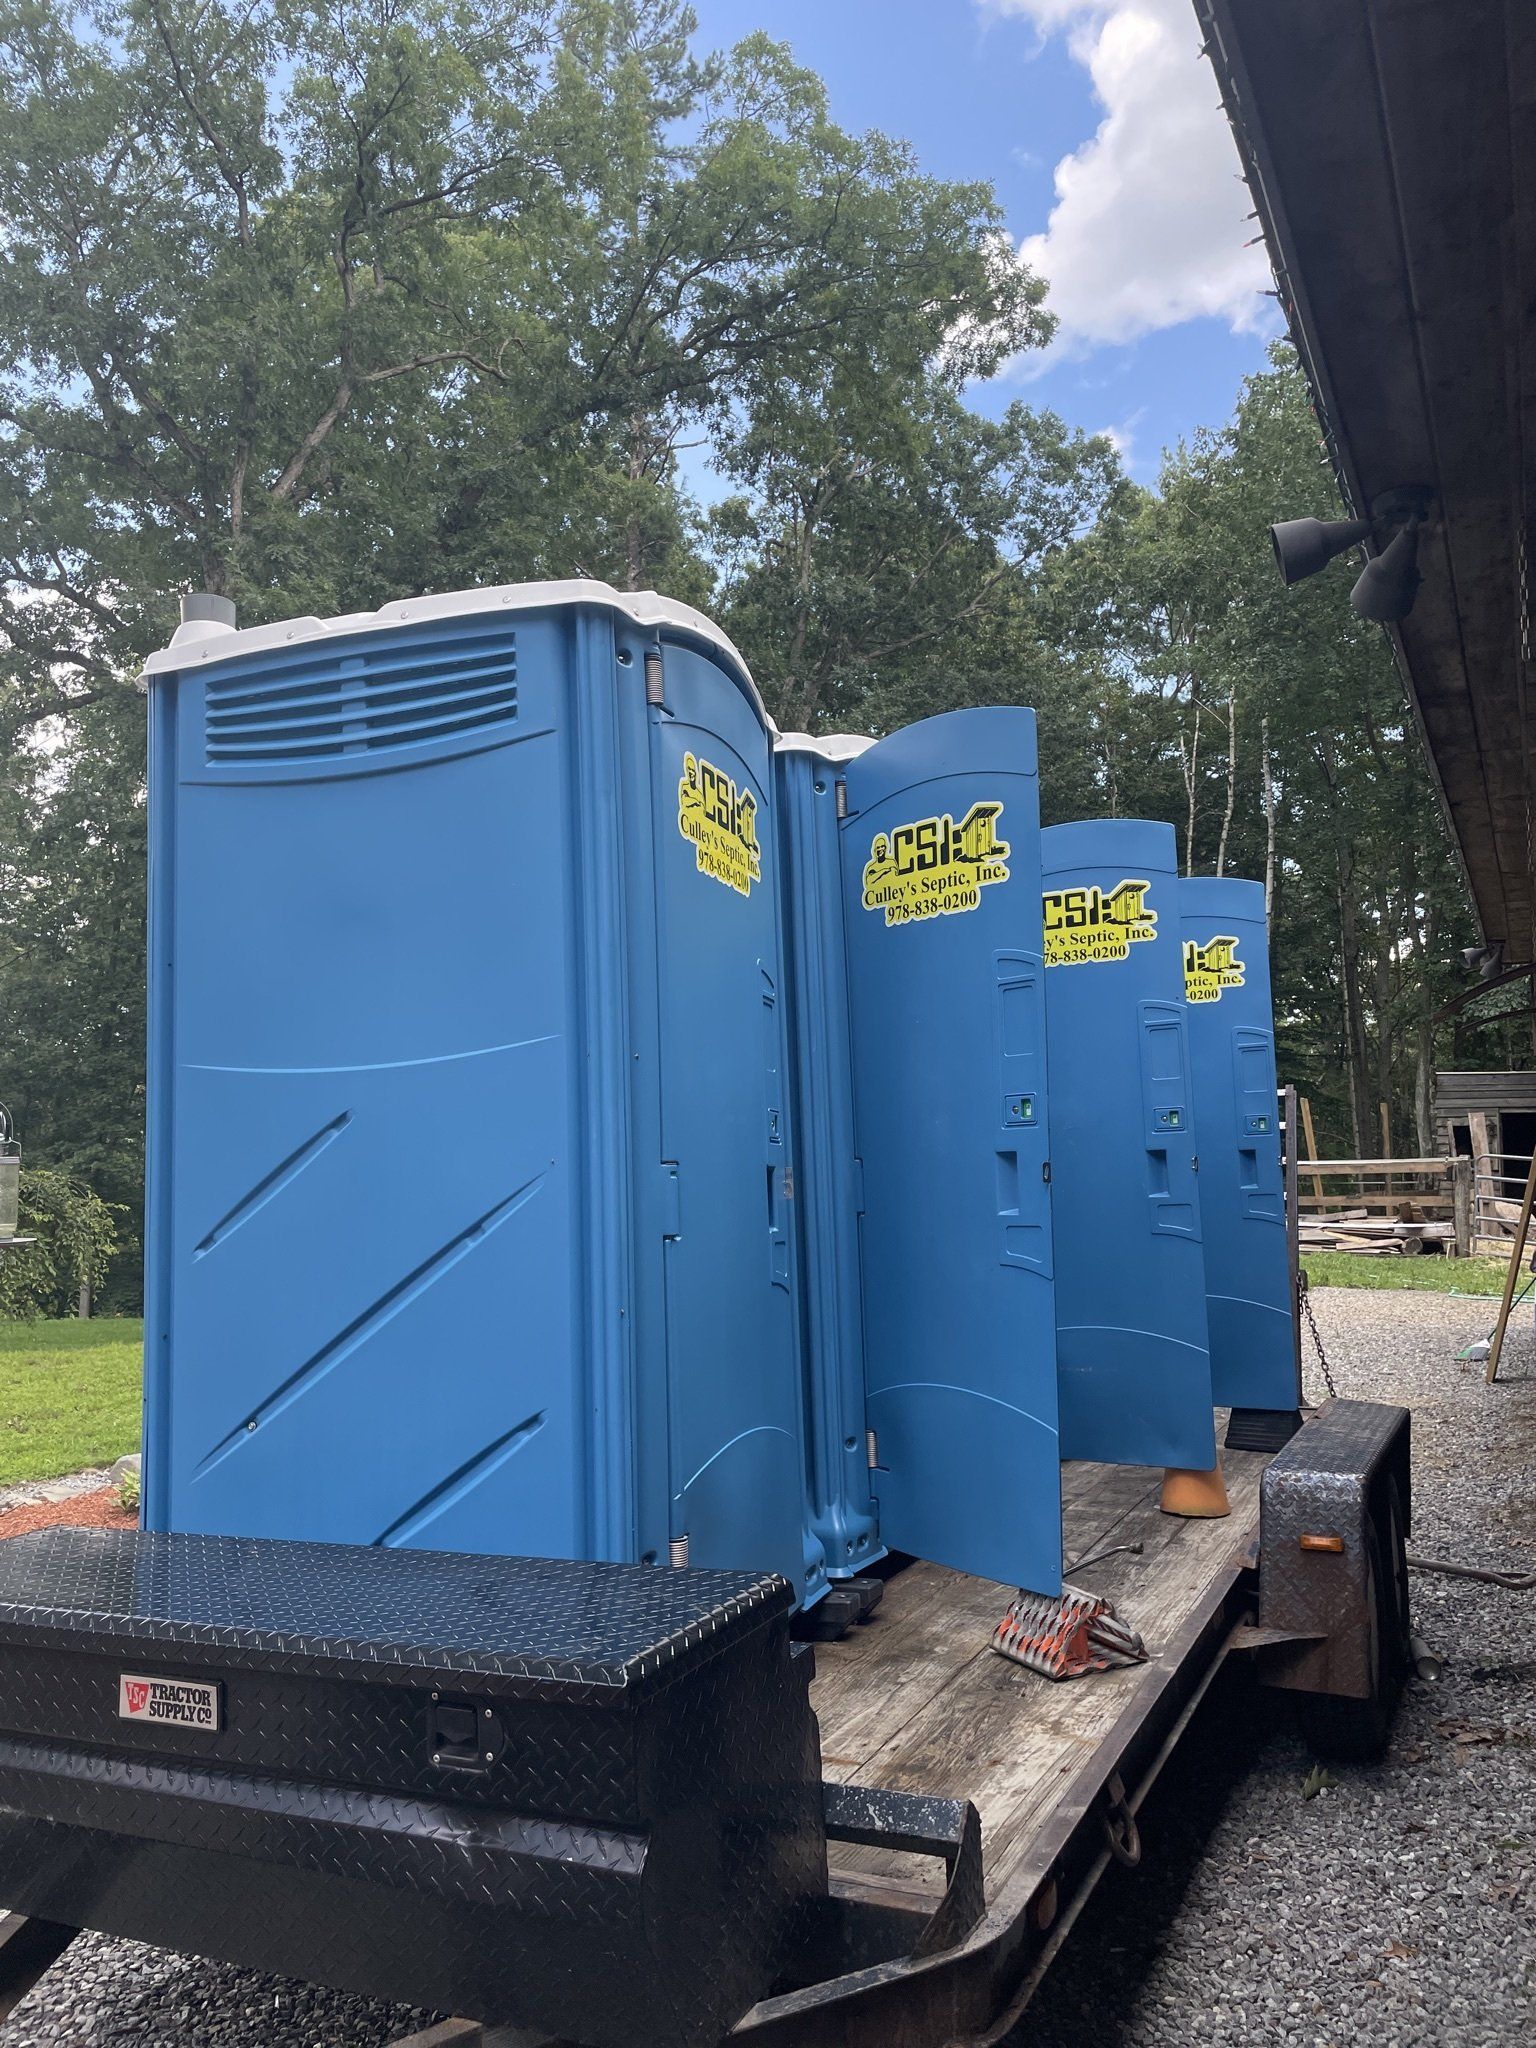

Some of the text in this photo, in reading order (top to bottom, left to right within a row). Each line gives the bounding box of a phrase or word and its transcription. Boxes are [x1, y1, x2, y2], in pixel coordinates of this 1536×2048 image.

[681, 814, 760, 877] Culley's Septic, Inc.
[698, 850, 749, 892] 978-838-0200
[865, 865, 1006, 905] Culley's Septic, Inc.
[888, 889, 977, 922] 978-838-0200
[1070, 930, 1120, 946] Septic,
[1125, 927, 1154, 939] Inc.
[1044, 945, 1126, 964] 78-838-0200
[1185, 974, 1242, 990] ptic, Inc.
[127, 1683, 146, 1708] TSC
[150, 1683, 212, 1706] TRACTOR
[149, 1701, 196, 1722] SUPPLY
